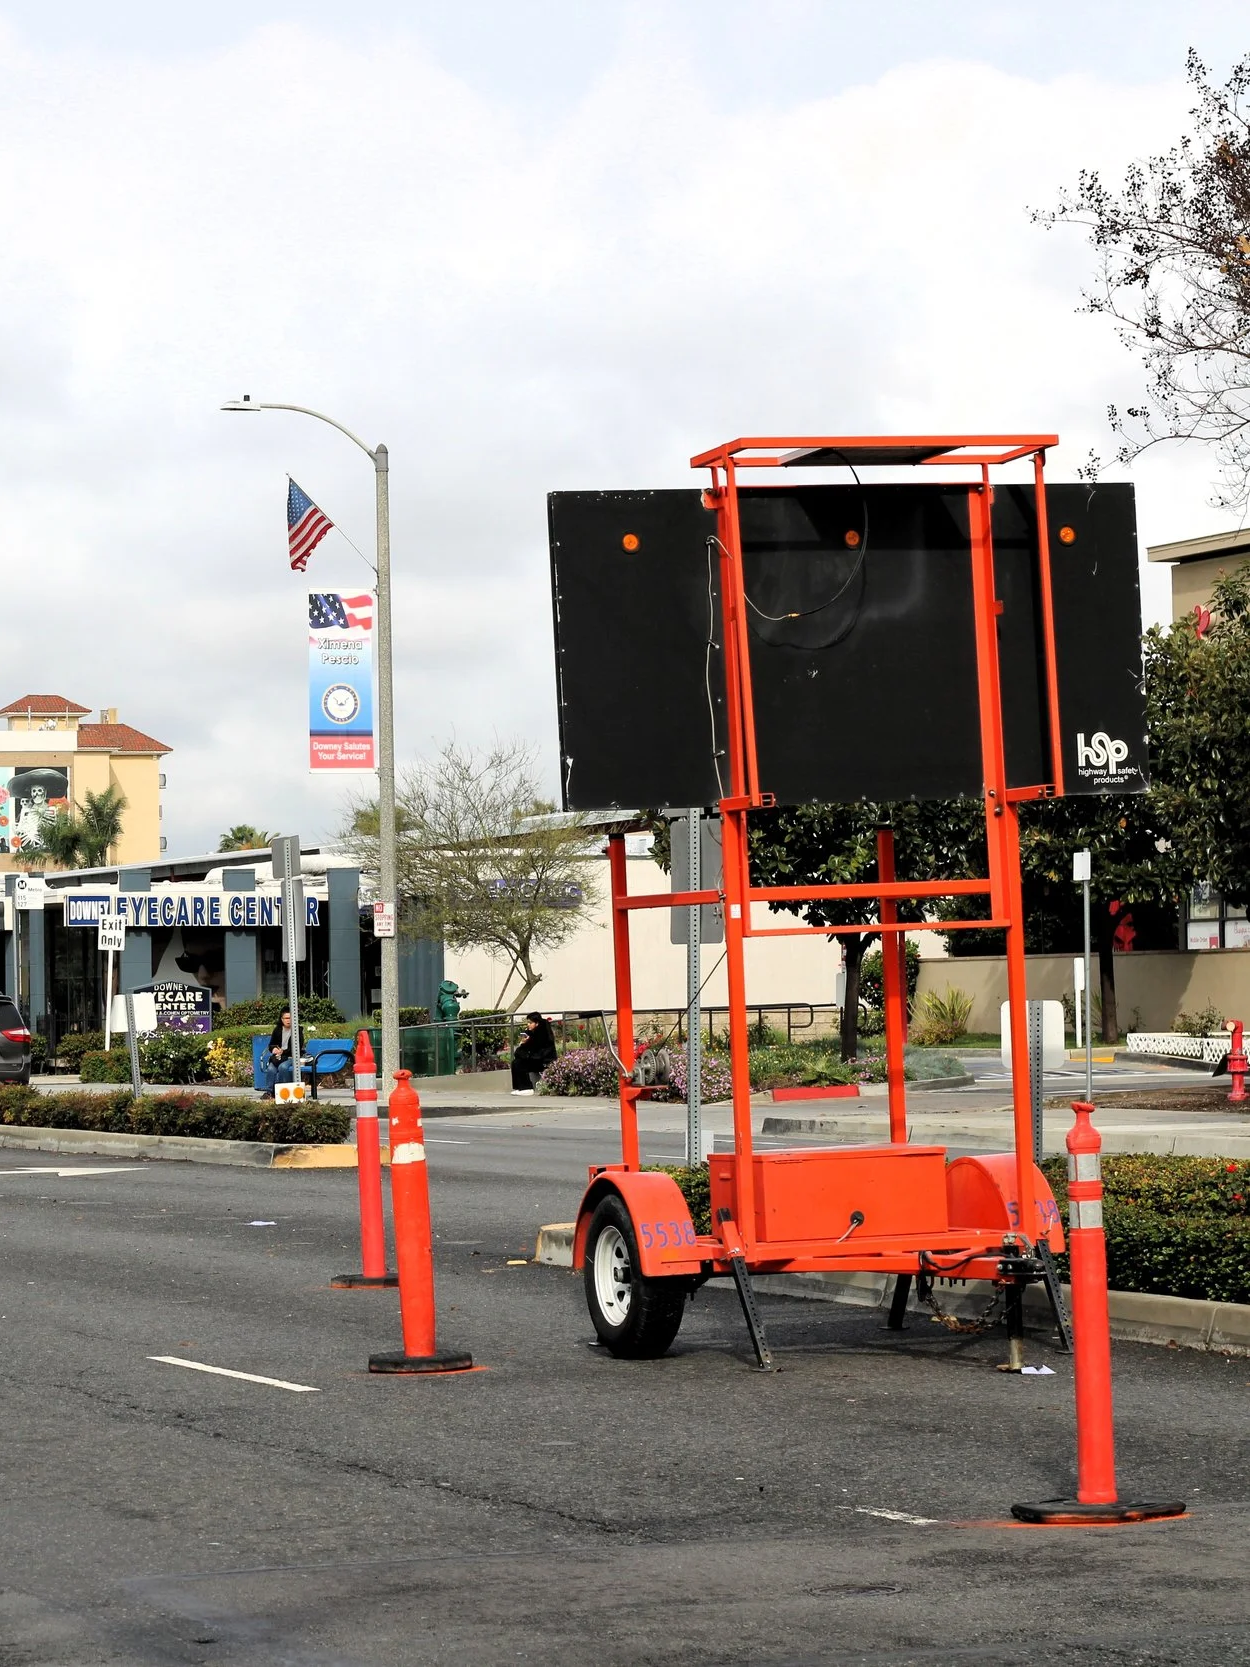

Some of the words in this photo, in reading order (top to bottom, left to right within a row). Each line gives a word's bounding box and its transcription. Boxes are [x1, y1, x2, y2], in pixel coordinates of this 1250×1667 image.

[318, 638, 362, 650] Ximena
[322, 653, 359, 665] Pescio
[313, 741, 342, 751] Downey
[344, 741, 371, 750] Salutes
[318, 752, 335, 760] Your
[337, 752, 366, 760] Service!
[1078, 768, 1107, 777] highway
[70, 900, 110, 920] DOWNEY
[116, 896, 221, 926] EYECARE
[230, 896, 320, 926] CENTR
[102, 919, 122, 931] Exit
[101, 935, 122, 948] Only
[154, 982, 189, 991] DOWNEY
[140, 992, 203, 1002] ECARE
[640, 1221, 696, 1248] 5538
